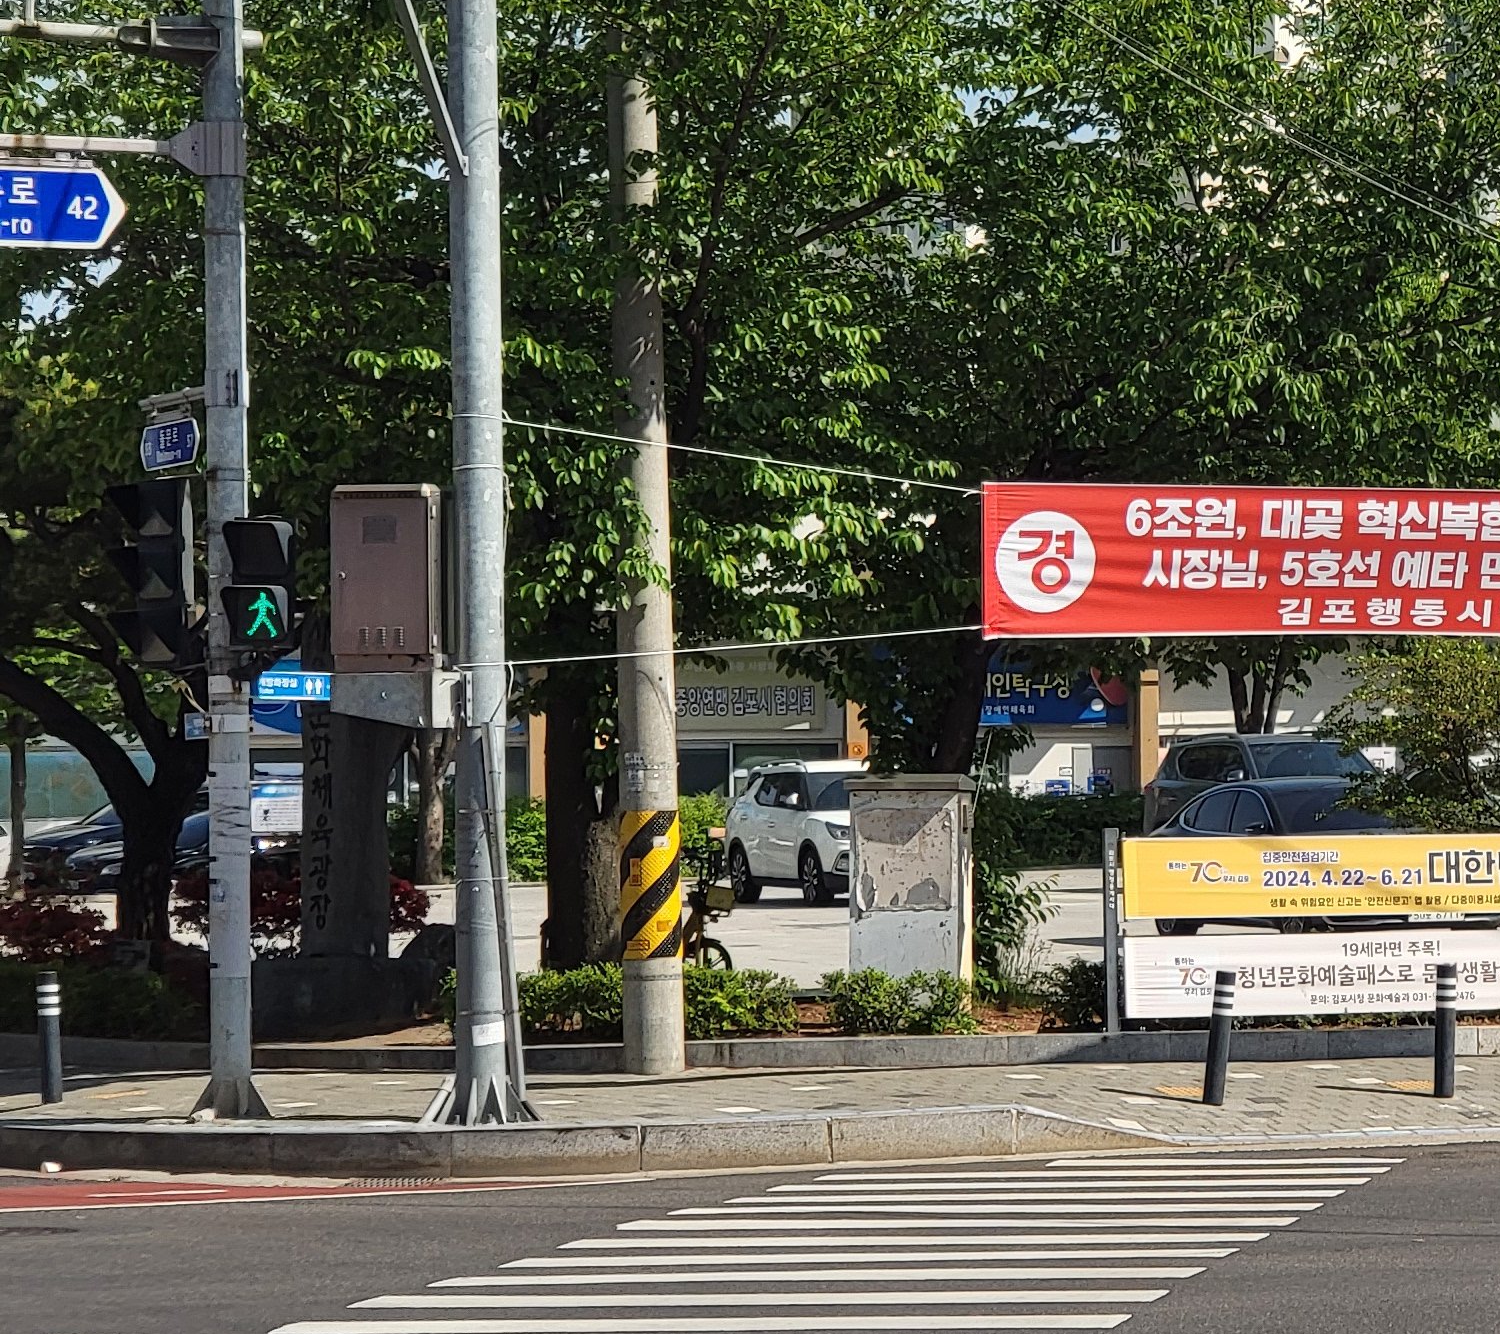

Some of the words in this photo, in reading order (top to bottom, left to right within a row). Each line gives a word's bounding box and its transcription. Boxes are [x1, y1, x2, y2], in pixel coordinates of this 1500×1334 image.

[66, 195, 99, 220] 42
[1125, 498, 1247, 540] 6조원,
[1260, 498, 1343, 540] 대곶
[1017, 528, 1075, 594] 경
[1142, 549, 1269, 591] 시장님,
[1280, 550, 1382, 588] 5호선
[1391, 550, 1469, 590] 예타
[732, 687, 772, 715] 김포시
[775, 686, 815, 715] 협의회
[1262, 851, 1339, 864] 집중안전점검기간
[1263, 870, 1317, 888] 2024.
[1270, 897, 1287, 907] 생활
[1290, 898, 1298, 907] 속
[1301, 897, 1334, 907] 위험요인
[1337, 897, 1362, 907] 신고는
[1425, 895, 1442, 905] 활용
[1451, 893, 1500, 905] 다중이용시설
[1341, 941, 1403, 958] 19세라면
[1407, 940, 1441, 957] 주목!
[1239, 964, 1416, 989] 청년문화예술패스로
[1310, 994, 1330, 1005] 문의:
[1332, 993, 1364, 1005] 김포시청
